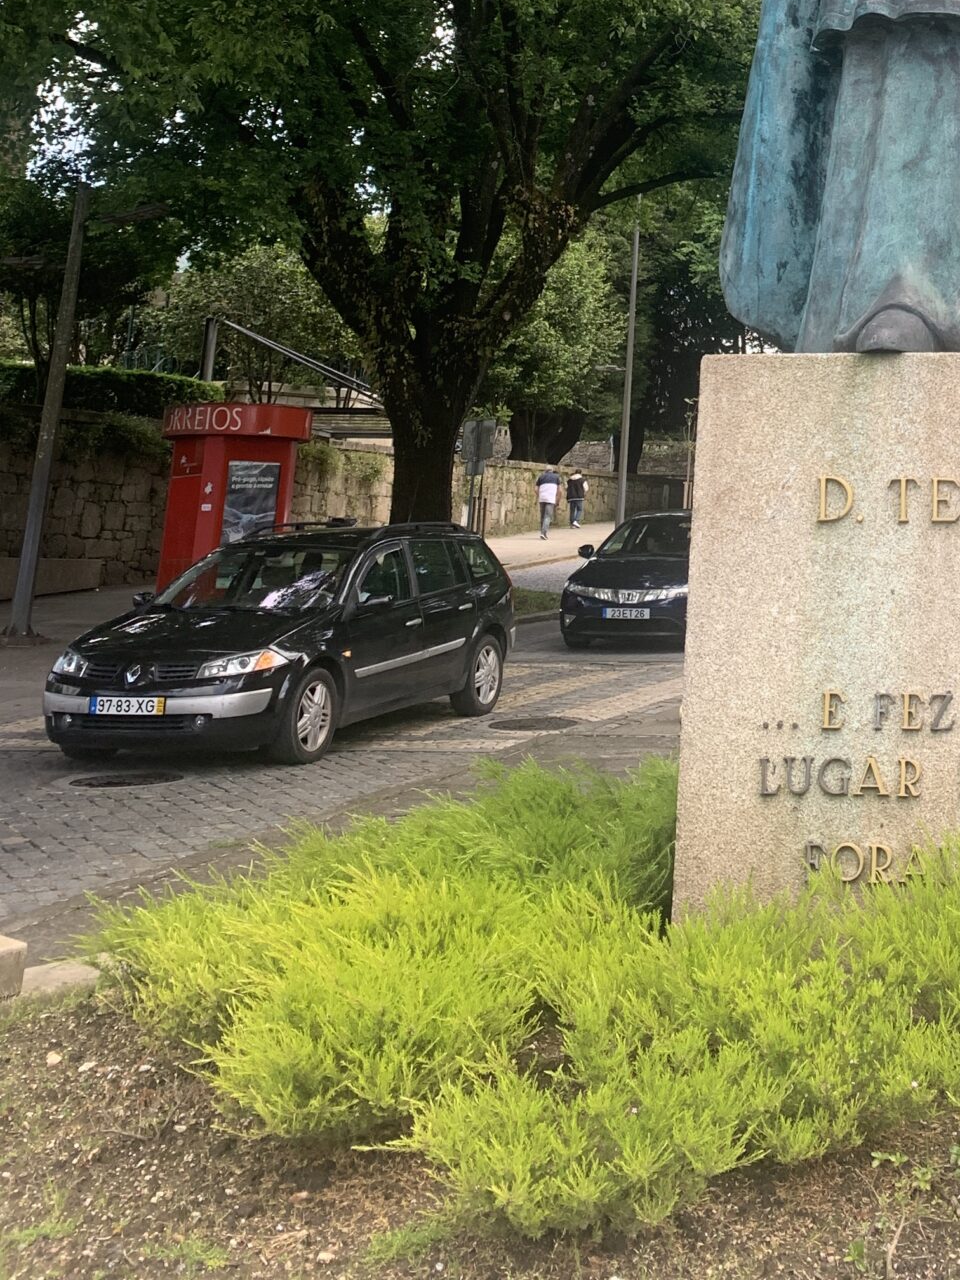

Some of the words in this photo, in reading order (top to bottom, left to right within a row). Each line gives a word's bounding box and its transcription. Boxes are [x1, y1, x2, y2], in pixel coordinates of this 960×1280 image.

[816, 475, 865, 524] D.
[821, 689, 848, 731] E
[871, 690, 956, 732] FEZ
[758, 755, 923, 798] LUGAR
